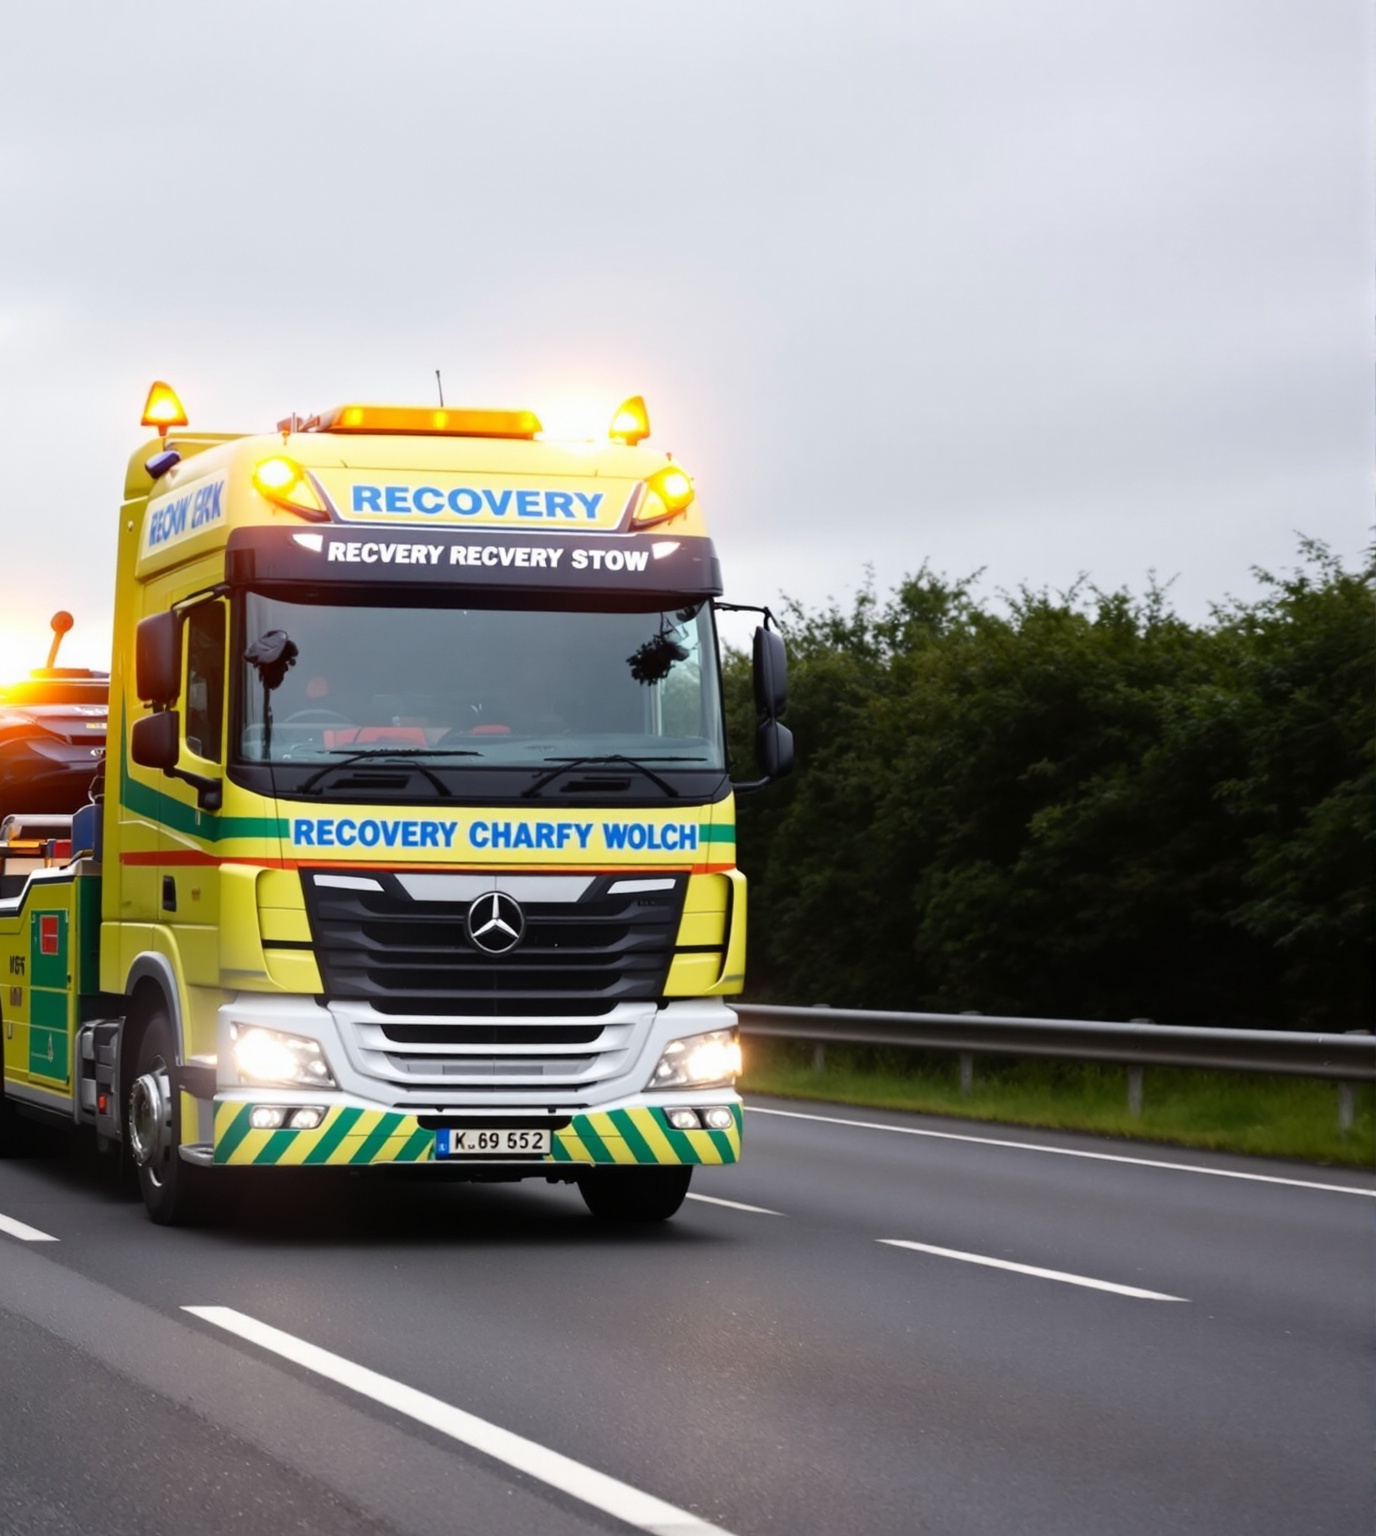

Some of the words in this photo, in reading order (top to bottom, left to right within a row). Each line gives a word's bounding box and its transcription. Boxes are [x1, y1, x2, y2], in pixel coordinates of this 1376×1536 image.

[352, 485, 603, 519] RECOVERY
[327, 541, 444, 565] RECVERY
[449, 545, 564, 568] RECVERY
[571, 549, 649, 572] STOW
[293, 818, 458, 848] RECOVERY
[468, 820, 594, 850] CHARFY
[602, 822, 697, 851] WOLCH
